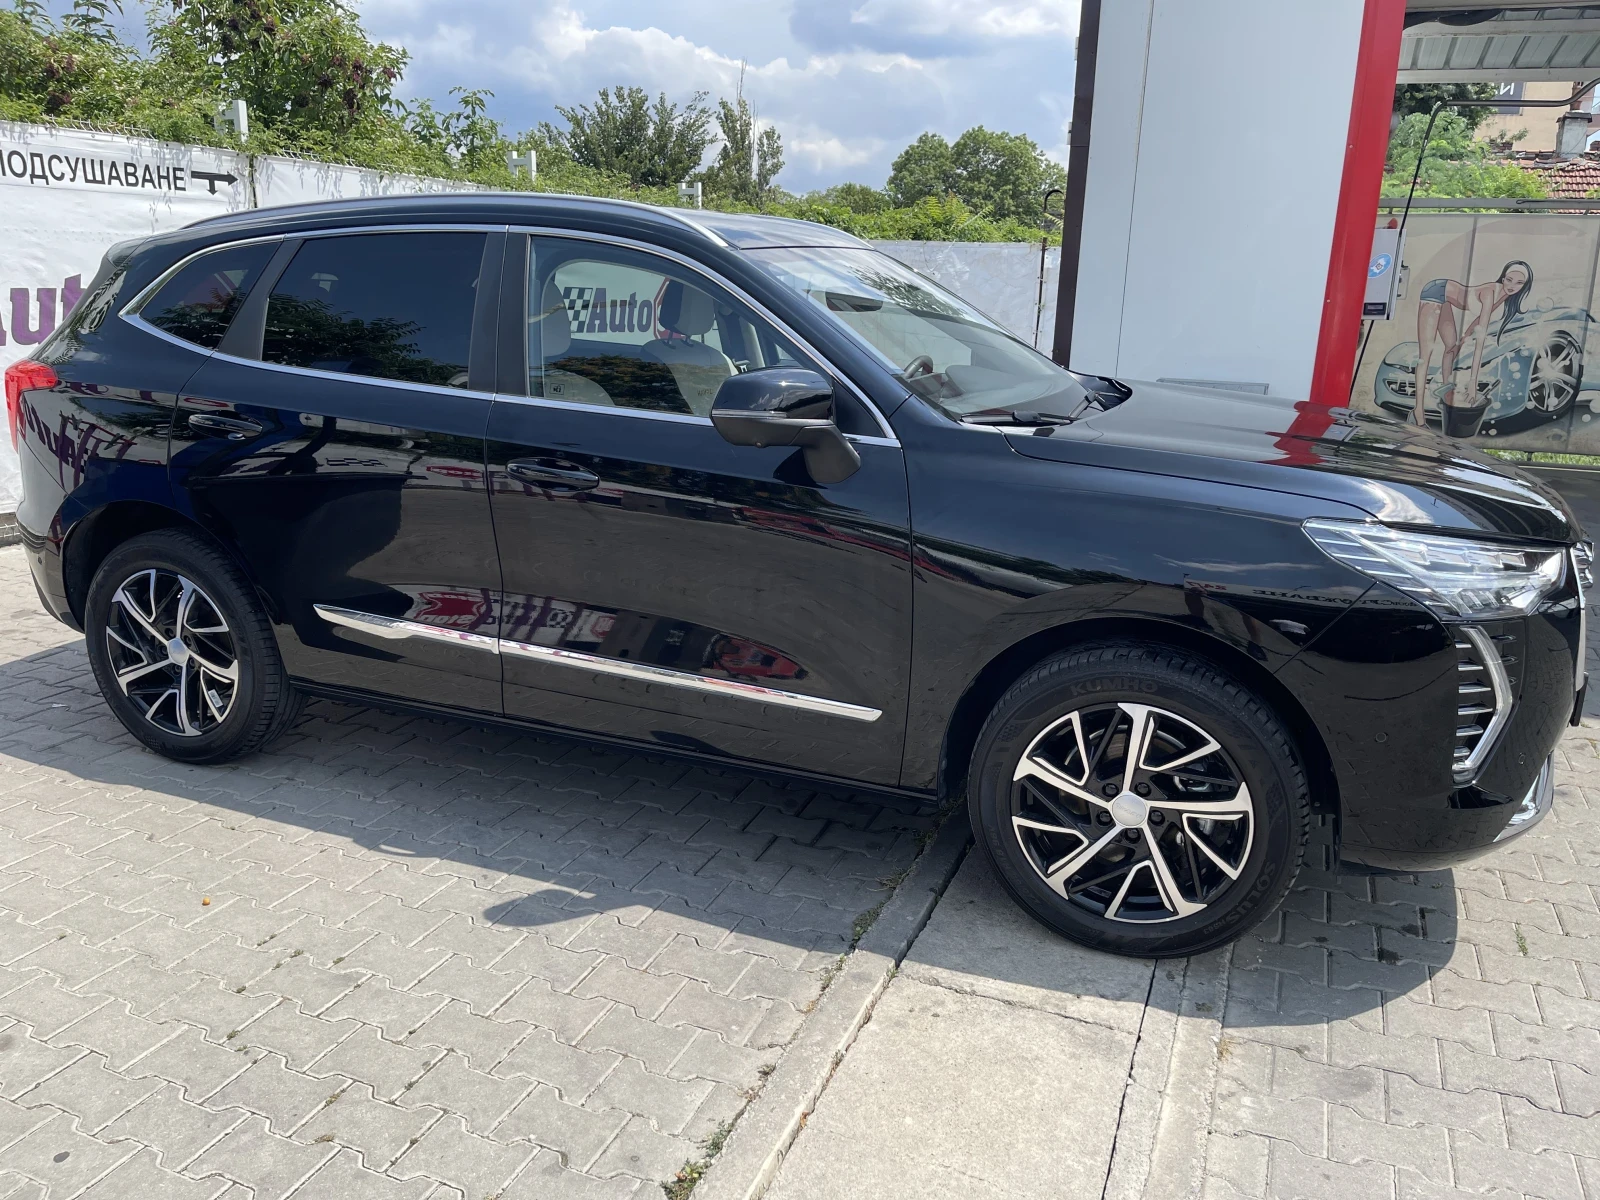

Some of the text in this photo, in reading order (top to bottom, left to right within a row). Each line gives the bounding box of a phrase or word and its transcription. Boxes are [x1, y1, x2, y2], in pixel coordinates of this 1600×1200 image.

[586, 287, 653, 333] Auto
[1070, 676, 1158, 696] KUMHO
[1226, 862, 1276, 925] SOLUS
